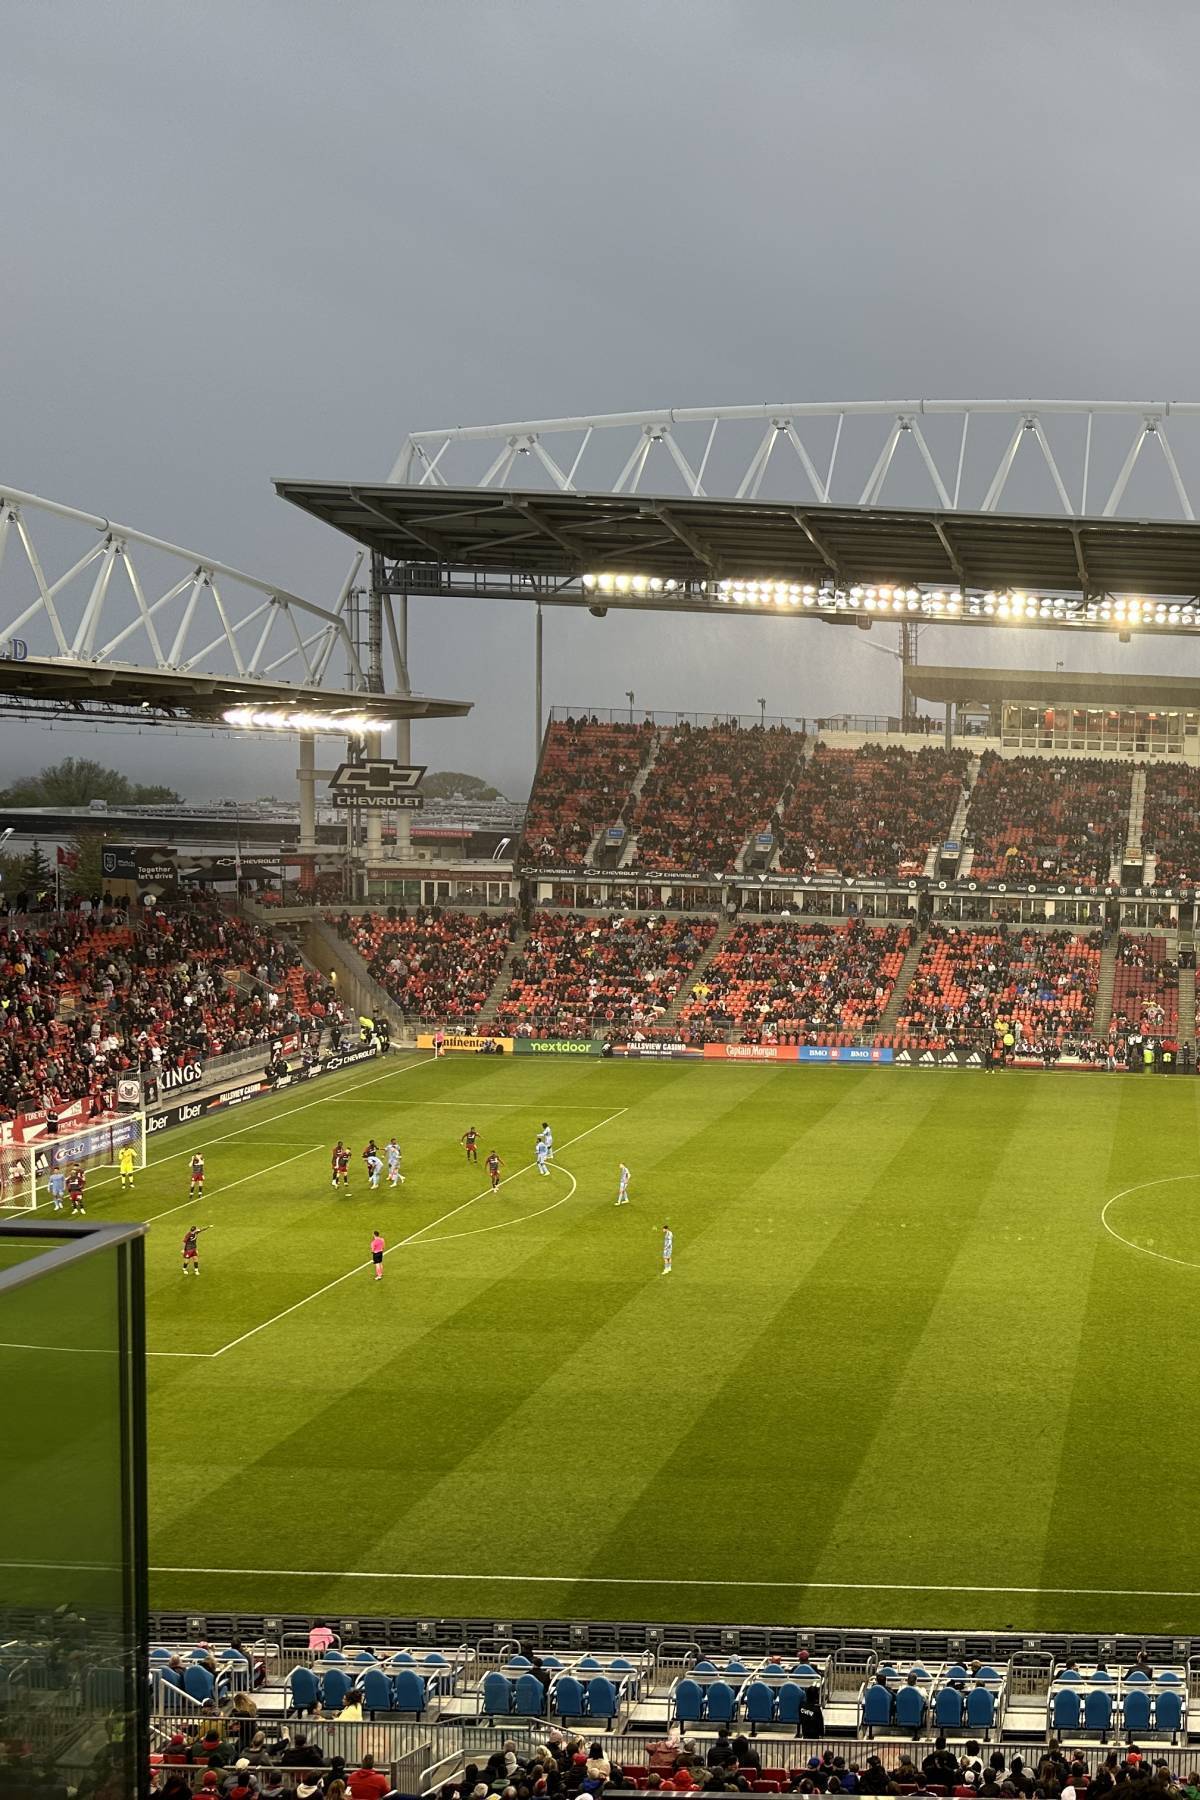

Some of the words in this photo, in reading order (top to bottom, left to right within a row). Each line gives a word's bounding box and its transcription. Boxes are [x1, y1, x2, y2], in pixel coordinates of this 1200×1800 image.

[336, 796, 420, 807] CHEVROLET
[138, 866, 171, 874] Together
[530, 1042, 592, 1054] nextdoor
[626, 1042, 661, 1051] FALLSVIEW
[662, 1043, 687, 1051] CASINO
[726, 1044, 751, 1057] Captain
[750, 1046, 778, 1058] Morgan
[343, 1048, 377, 1064] CHEVROLET
[809, 1049, 828, 1057] BMO
[179, 1103, 202, 1122] Uber
[54, 1143, 85, 1161] Crest
